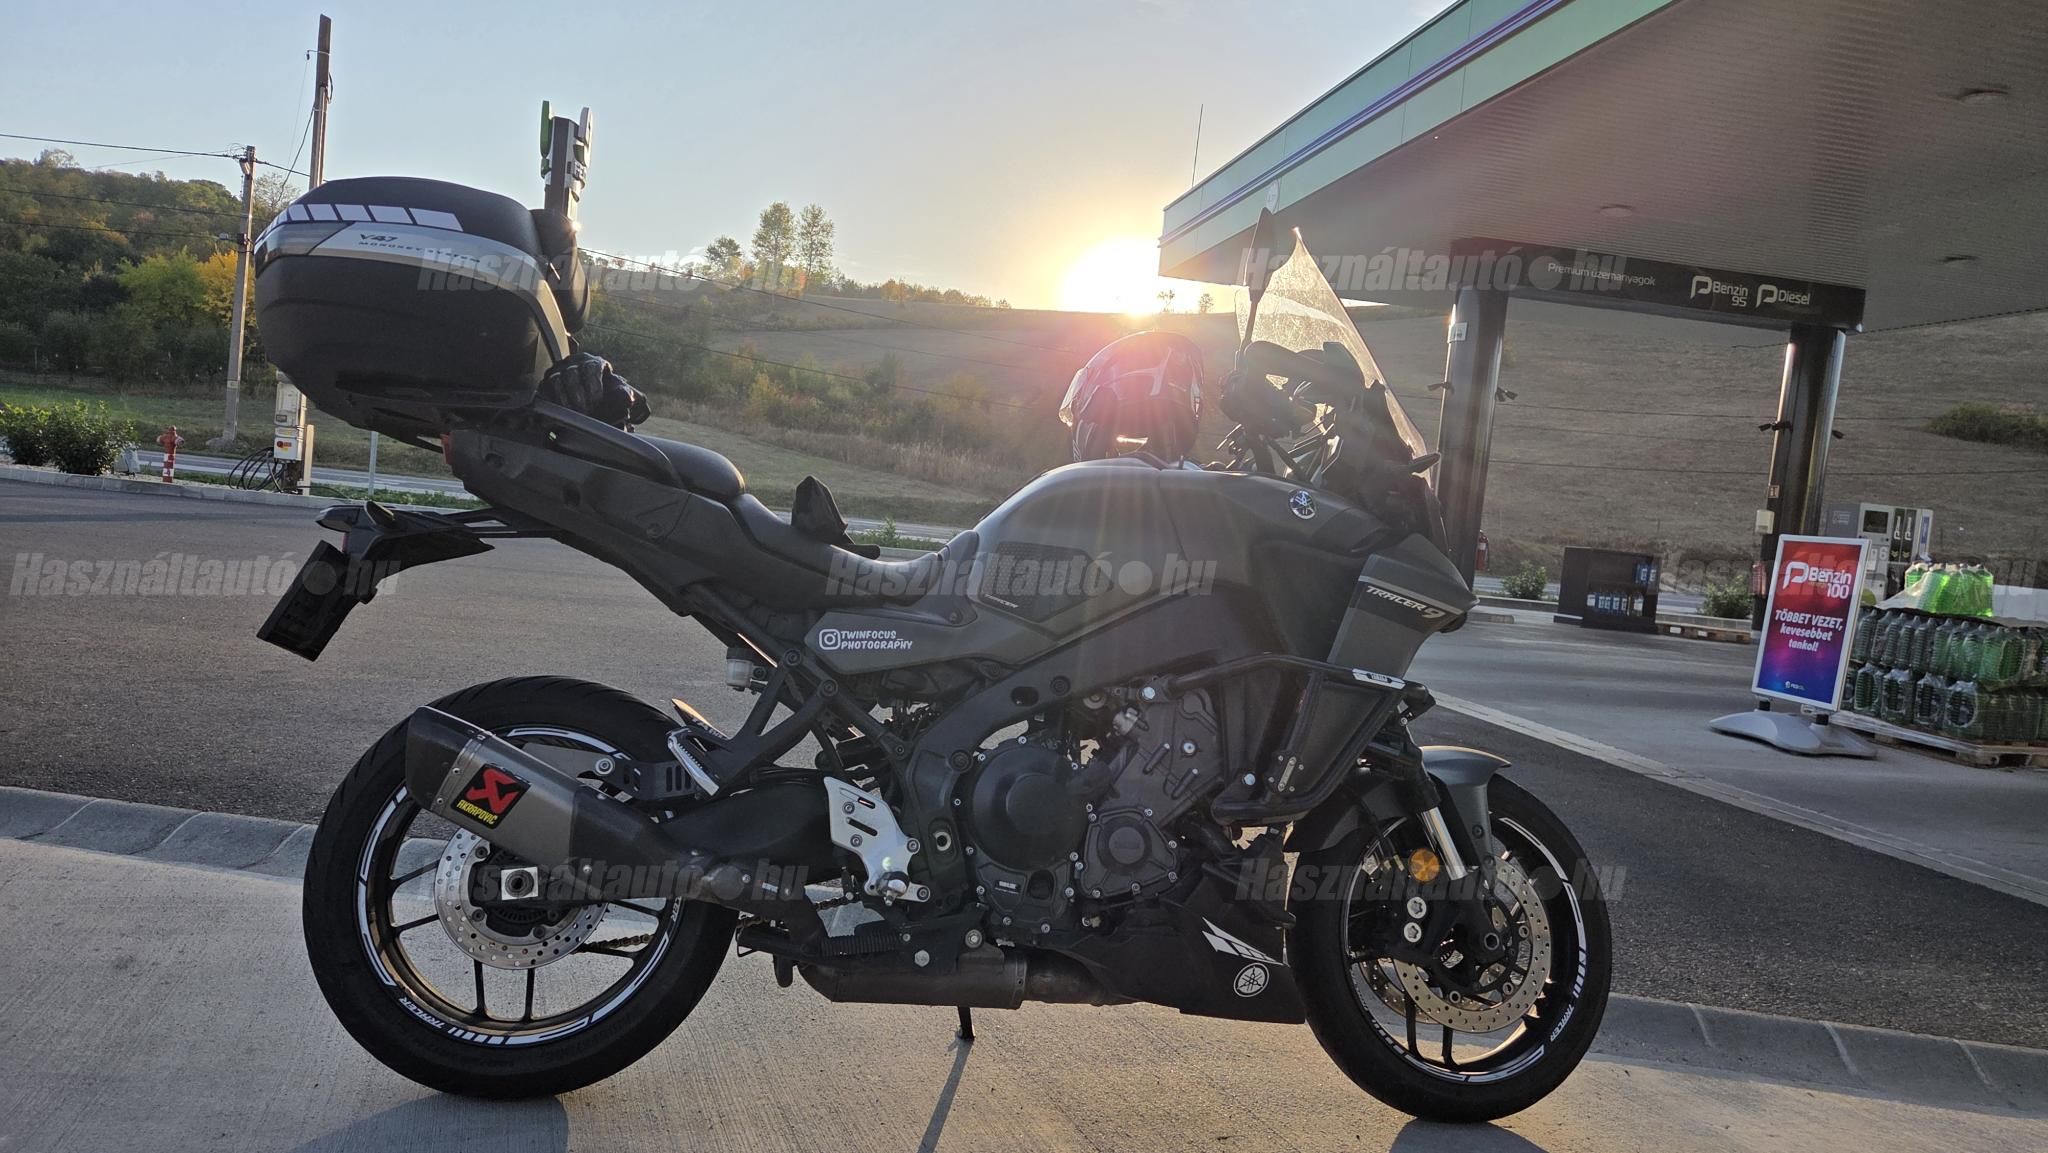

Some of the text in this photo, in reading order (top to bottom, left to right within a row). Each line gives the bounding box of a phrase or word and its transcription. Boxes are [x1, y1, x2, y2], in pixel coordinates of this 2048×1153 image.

[1712, 281, 1749, 297] Benzin
[1778, 289, 1811, 305] Diesel
[1731, 296, 1748, 308] 95
[1808, 566, 1852, 585] Benzin
[1366, 585, 1428, 611] TRACER
[1827, 583, 1849, 600] 100
[1775, 608, 1844, 632] TÖBBET VEZET,
[1780, 622, 1833, 641] kevesebbet
[841, 640, 913, 650] PHOTOGRAPHY
[1788, 639, 1820, 652] tankol!
[398, 996, 446, 1029] TRACER
[1550, 1003, 1575, 1042] TRACER
